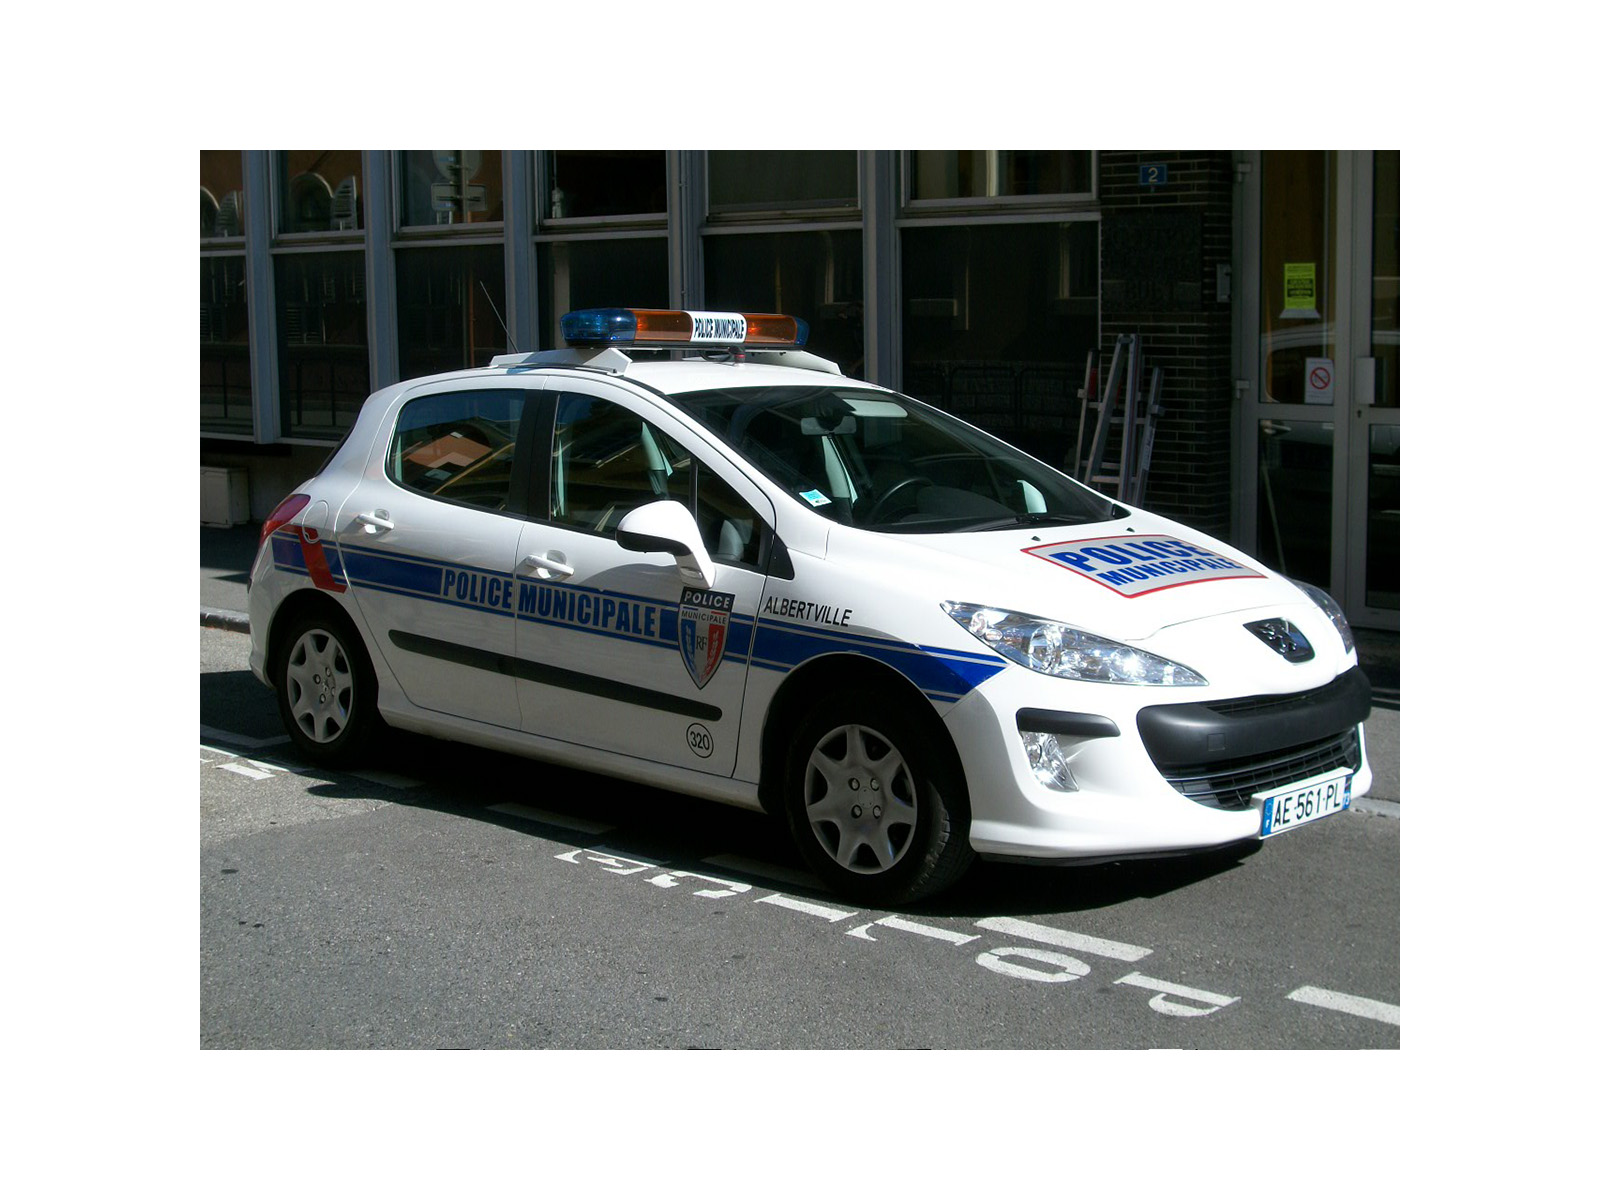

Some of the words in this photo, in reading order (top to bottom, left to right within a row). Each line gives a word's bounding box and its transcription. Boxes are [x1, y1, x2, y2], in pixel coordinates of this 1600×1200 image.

[1148, 167, 1158, 182] 2
[694, 318, 714, 338] POLICE
[714, 319, 744, 339] MUNICIPALE
[1048, 540, 1214, 572] POLICE
[1096, 557, 1244, 586] MUNICIPALE
[443, 569, 514, 609] POLICE
[518, 583, 656, 637] MUNICIPALE
[684, 591, 730, 609] POLICE
[681, 610, 727, 625] MUNICIPALE
[763, 596, 852, 627] ALBERTVILLE
[690, 731, 710, 750] 320
